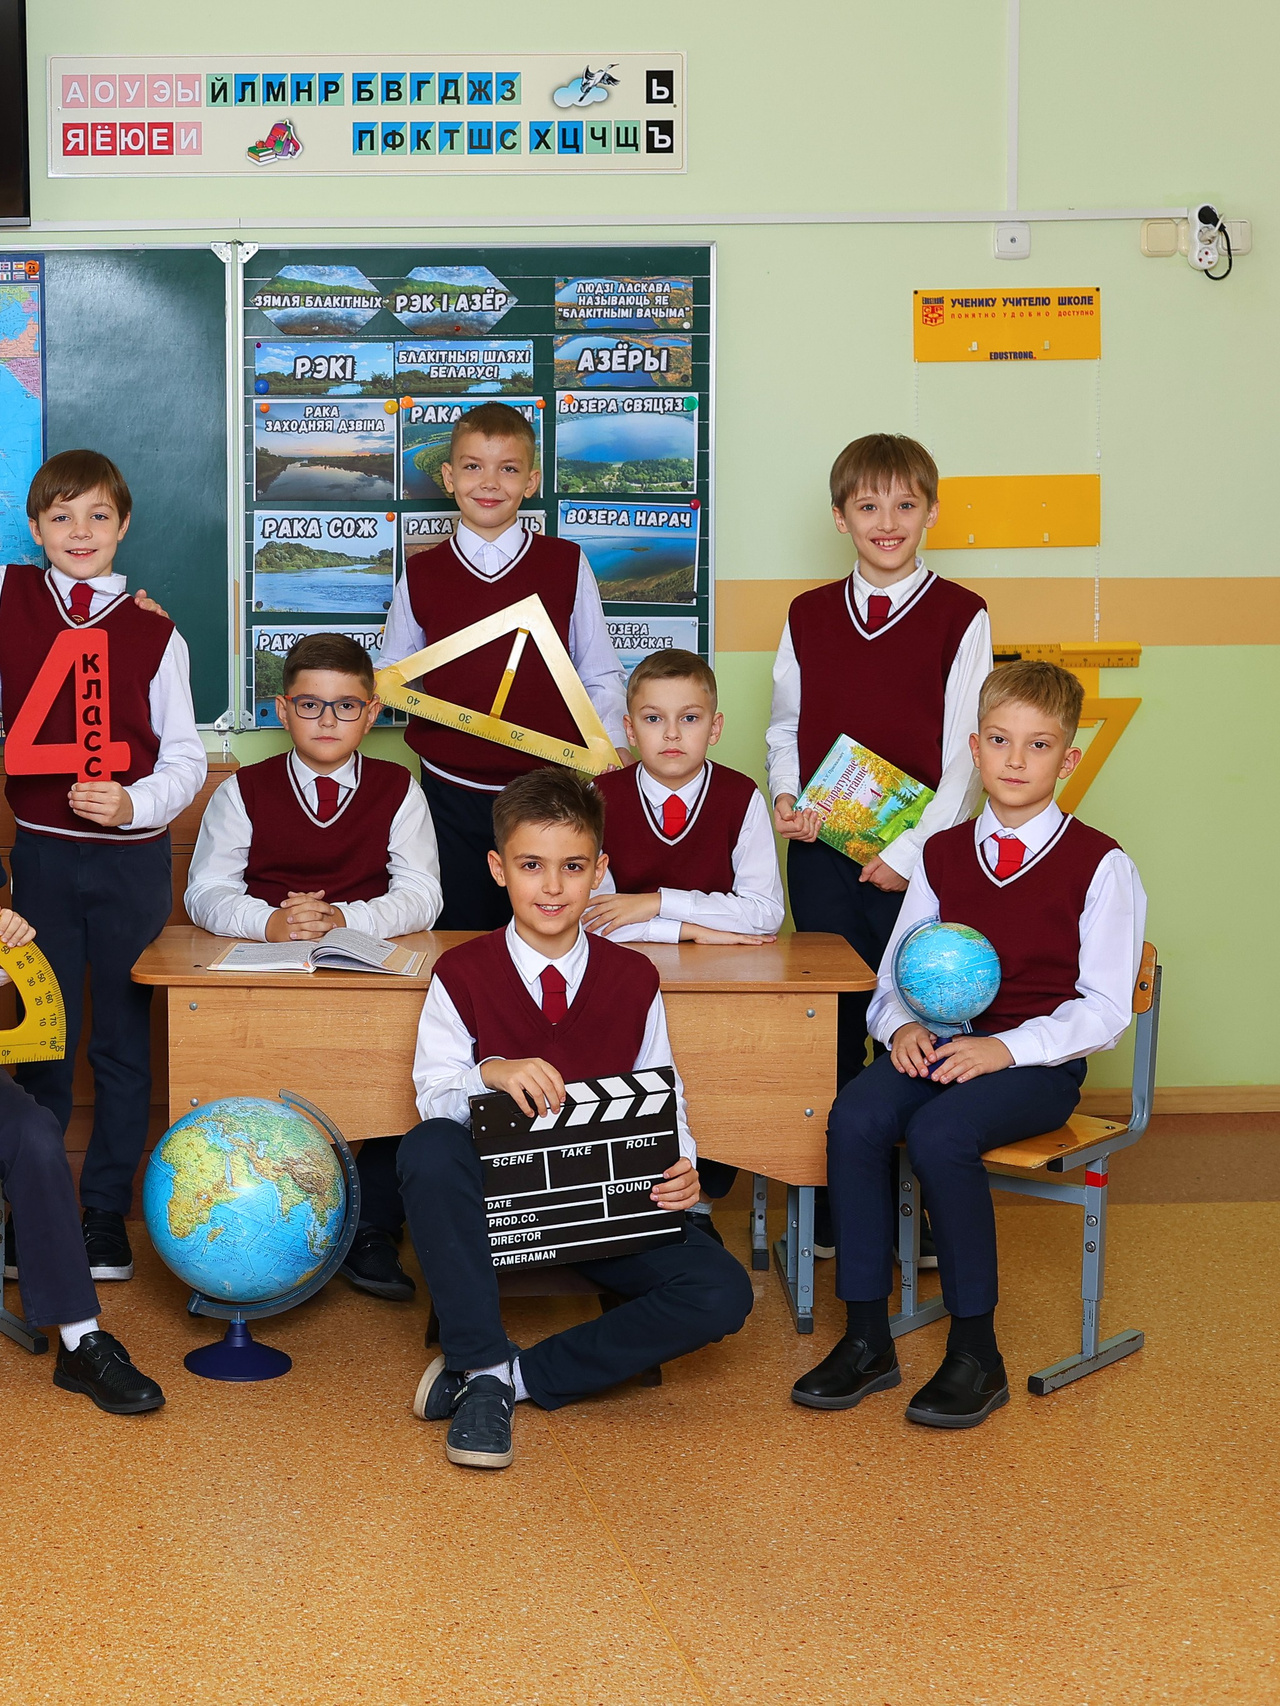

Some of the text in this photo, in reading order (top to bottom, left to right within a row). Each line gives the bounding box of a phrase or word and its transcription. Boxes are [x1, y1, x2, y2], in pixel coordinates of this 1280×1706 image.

[576, 282, 671, 294] ЛЮДЗІ ЛАСКАВА
[254, 294, 384, 309] ЗЯМЛЯ БЛАКІТНЫХ
[395, 293, 435, 312] РЭК
[455, 288, 508, 312] АЗЁР
[578, 295, 669, 307] НАЗЫВАЮЦЬ ЯЕ
[950, 297, 997, 308] УЧЕНИКУ
[1002, 296, 1051, 307] УЧИТЕЛЮ
[1057, 295, 1093, 306] ШКОЛЕ
[1058, 309, 1094, 317] ДОСТУПНО
[398, 350, 530, 364] БЛАКІТНЫЯ ШЛЯХІ
[577, 342, 669, 372] АЗЁРЫ
[294, 355, 355, 380] РЭКІ
[430, 366, 499, 379] БЕЛАРУСІ
[304, 405, 340, 418] РАКА
[623, 397, 687, 414] СВЯЦЯЗ
[410, 405, 463, 424] РАКА
[265, 419, 385, 432] ЗАХОДНЯЯ ДЗВІНА
[565, 508, 692, 527] ВОЗЕРА НАРАЧ
[262, 517, 378, 538] РАКА СОЖ
[407, 518, 454, 535] РАКА
[258, 634, 306, 651] РАК
[4, 628, 131, 783] 4 класс
[406, 695, 575, 759] 40 30 20 10
[841, 766, 868, 801] чытанне
[870, 788, 882, 798] 1
[492, 1137, 657, 1168] SCENE TAKE ROLL
[607, 1181, 652, 1195] SOUND
[487, 1200, 512, 1210] DATE
[489, 1213, 539, 1227] PROD.CO.
[490, 1231, 542, 1247] DIRECTOR
[492, 1250, 556, 1267] CAMERAMAN
